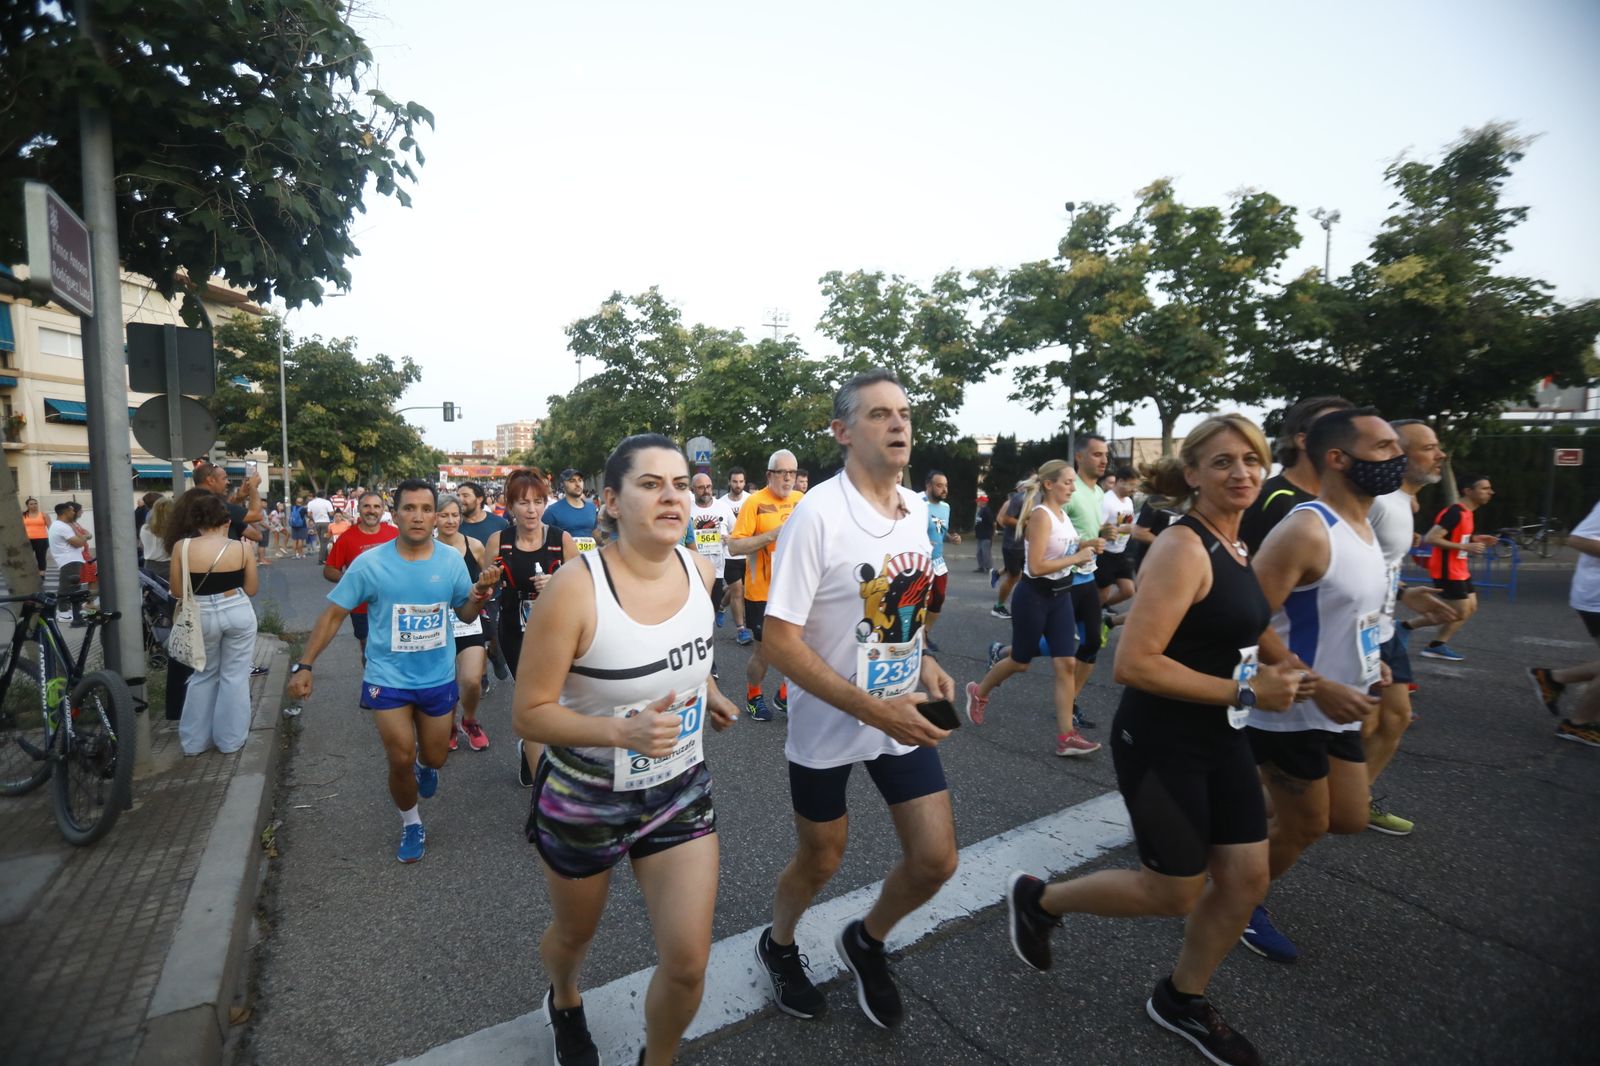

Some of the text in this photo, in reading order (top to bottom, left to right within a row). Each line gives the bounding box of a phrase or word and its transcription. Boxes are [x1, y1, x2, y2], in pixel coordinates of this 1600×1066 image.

[701, 535, 716, 543] 564
[579, 543, 592, 551] 391
[403, 614, 440, 629] 1732
[669, 637, 706, 671] 076
